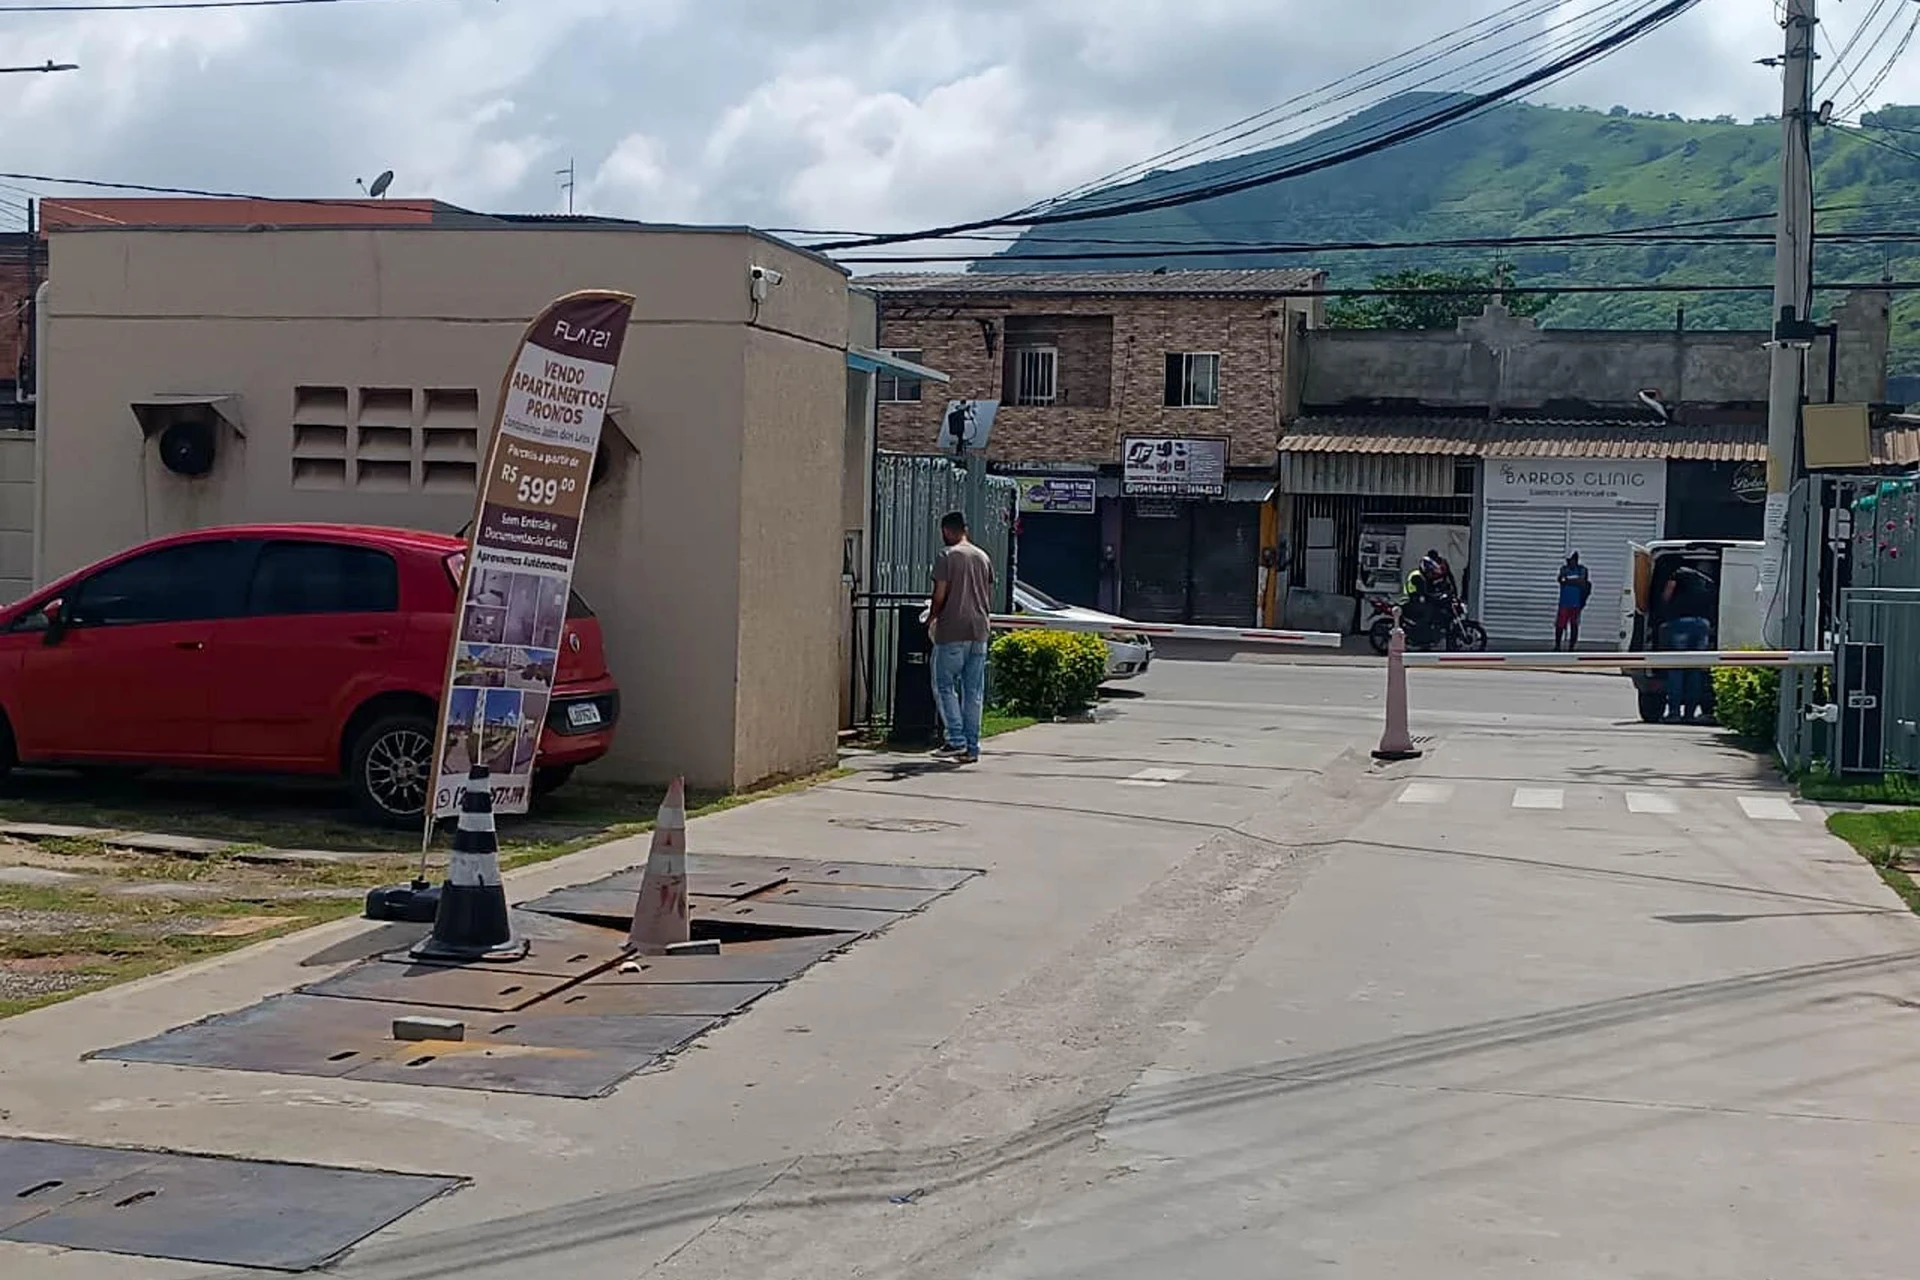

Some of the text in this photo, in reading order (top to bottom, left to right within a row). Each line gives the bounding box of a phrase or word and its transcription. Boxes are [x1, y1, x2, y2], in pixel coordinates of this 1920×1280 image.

[545, 360, 584, 385] VENDO
[512, 371, 607, 410] APARTAMENTOS
[527, 399, 584, 425] PRONTOS
[1129, 446, 1152, 460] JF
[501, 464, 519, 483] R$
[517, 475, 559, 505] 599
[1505, 472, 1645, 487] BARROS CLINIC
